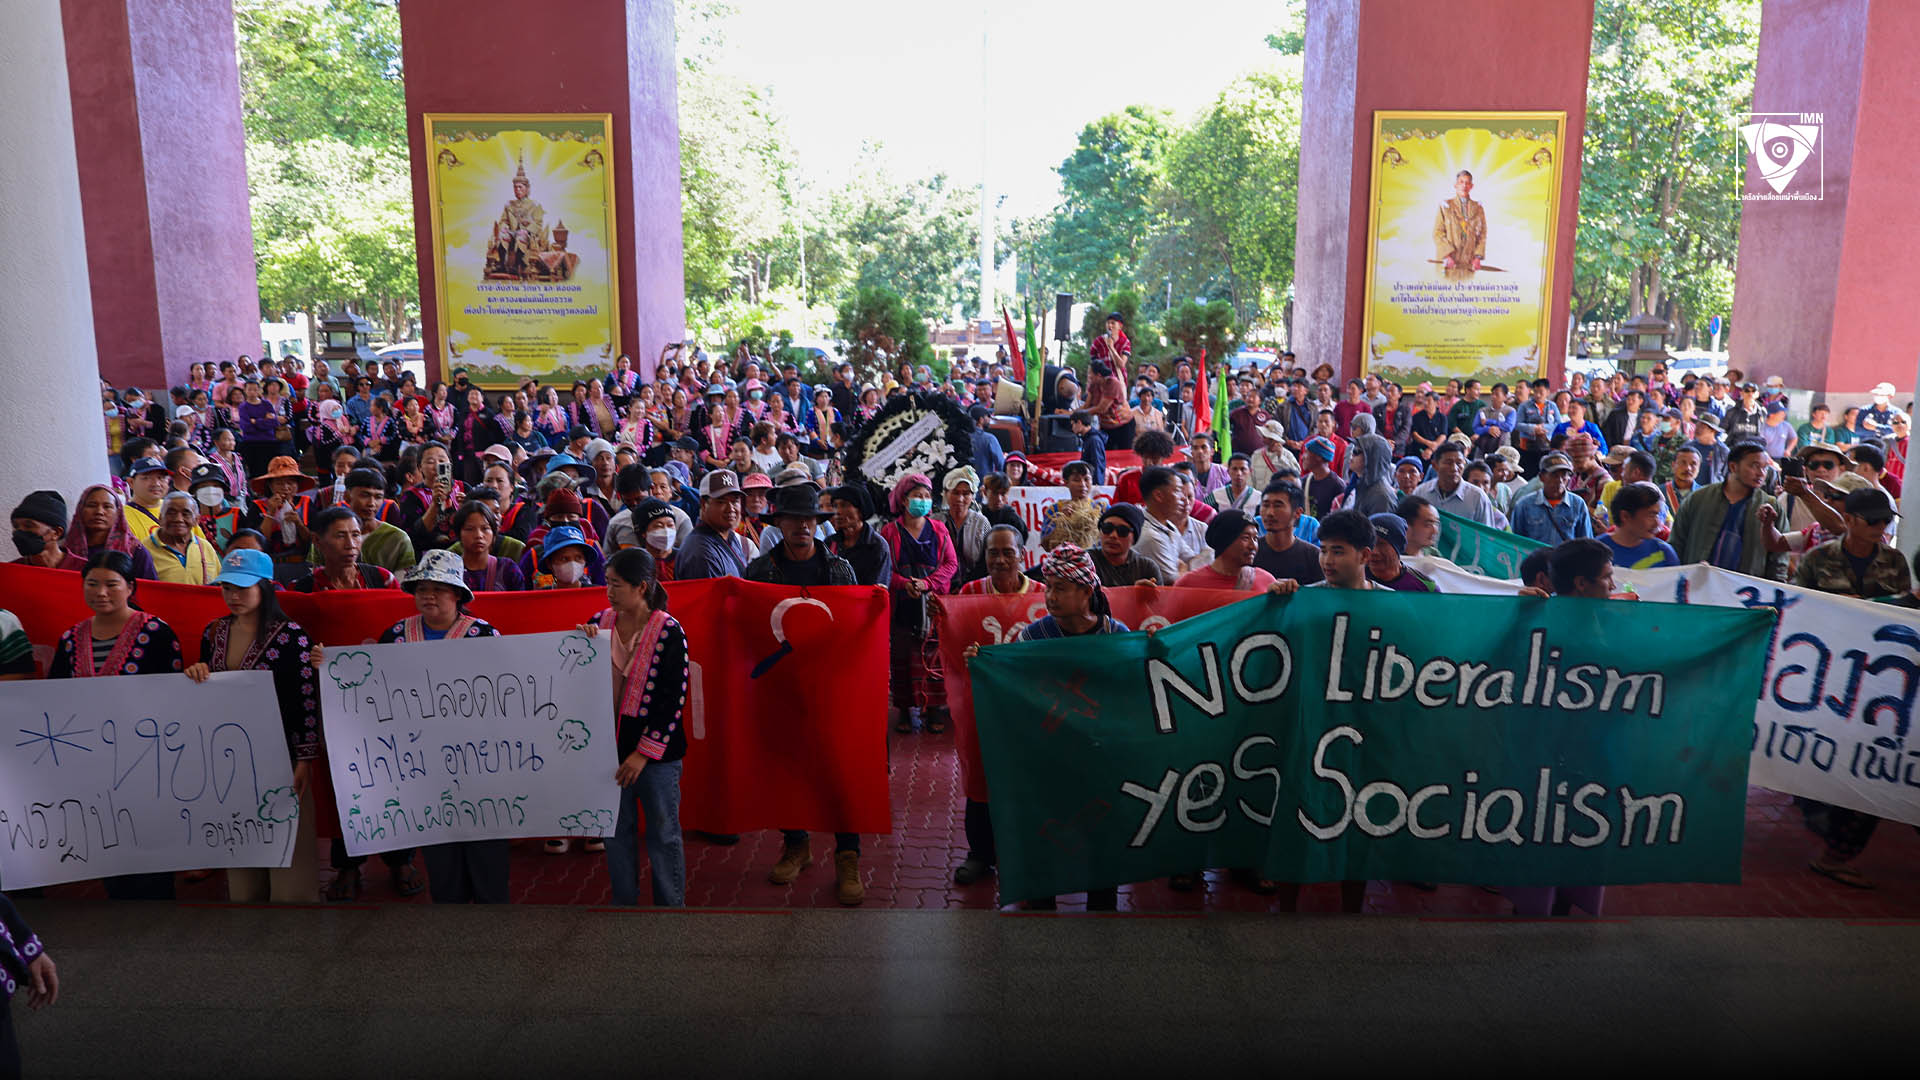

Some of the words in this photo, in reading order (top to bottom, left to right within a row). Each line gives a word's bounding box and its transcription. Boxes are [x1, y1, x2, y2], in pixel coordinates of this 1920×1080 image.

[366, 667, 559, 723] ป่าปลอดคน
[1146, 630, 1293, 734] NO
[1324, 612, 1667, 718] Liberalism
[348, 729, 427, 789] ป่าไม้
[440, 738, 545, 791] อุทยาน
[1298, 724, 1688, 849] Socialism
